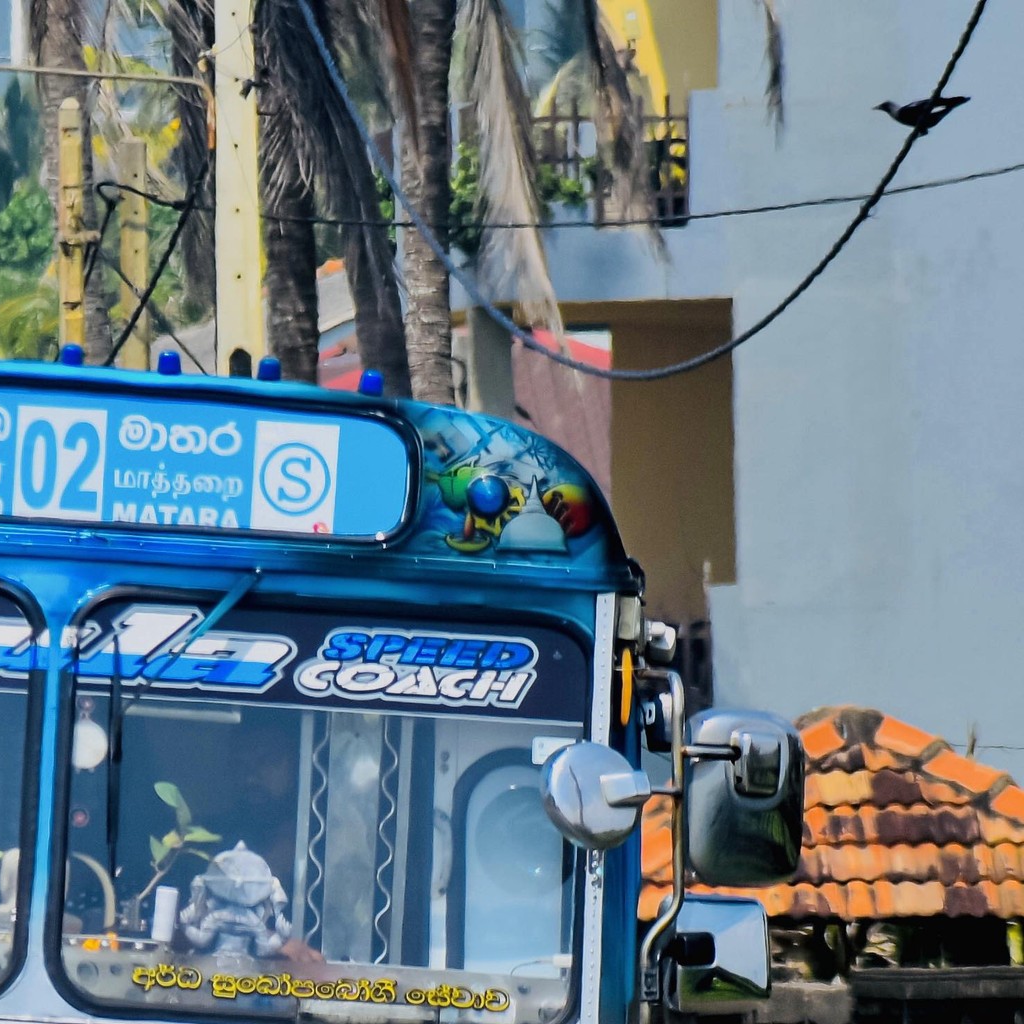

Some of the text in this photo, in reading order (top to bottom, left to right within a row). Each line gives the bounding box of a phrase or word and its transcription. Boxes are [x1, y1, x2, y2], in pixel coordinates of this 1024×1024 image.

[119, 414, 242, 456] මාතර
[20, 418, 100, 513] 02
[112, 503, 238, 529] MATARA
[323, 631, 534, 670] SPEED
[298, 661, 530, 702] COACH
